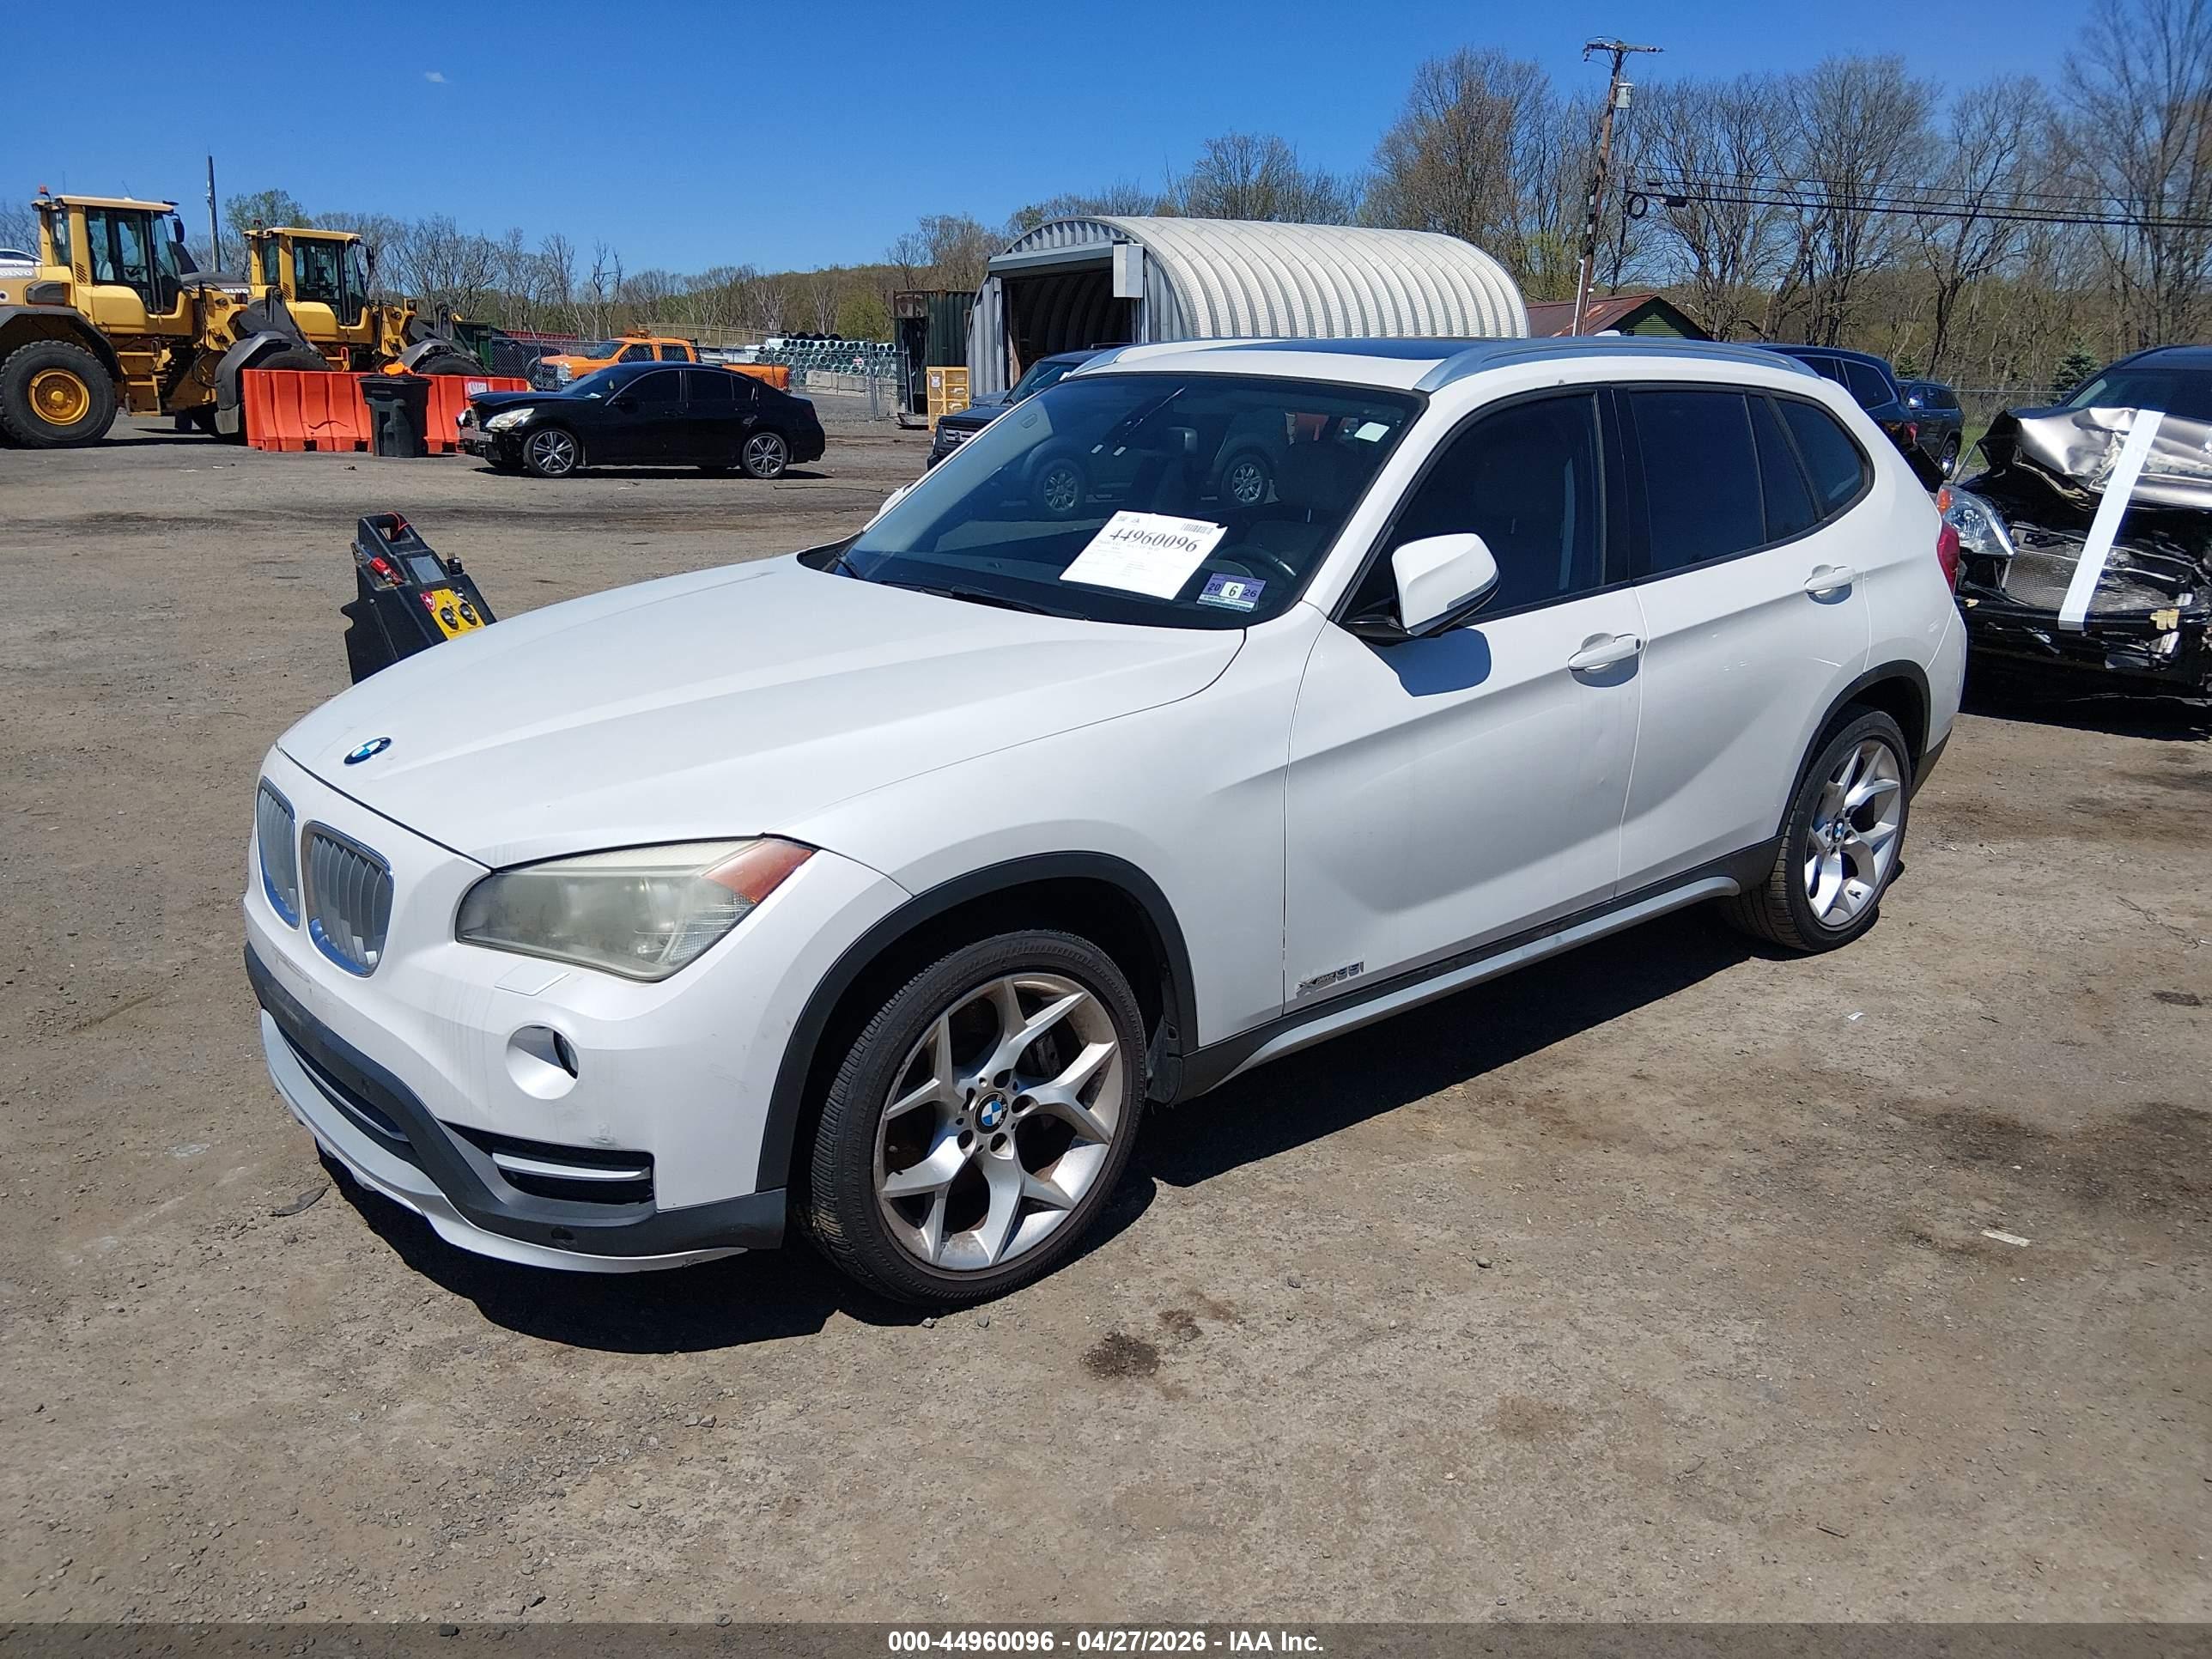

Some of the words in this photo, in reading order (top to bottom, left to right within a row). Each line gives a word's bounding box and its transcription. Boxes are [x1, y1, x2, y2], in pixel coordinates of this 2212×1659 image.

[1109, 528, 1203, 553] 44960096
[1228, 585, 1239, 597] 6
[1243, 588, 1258, 598] 26
